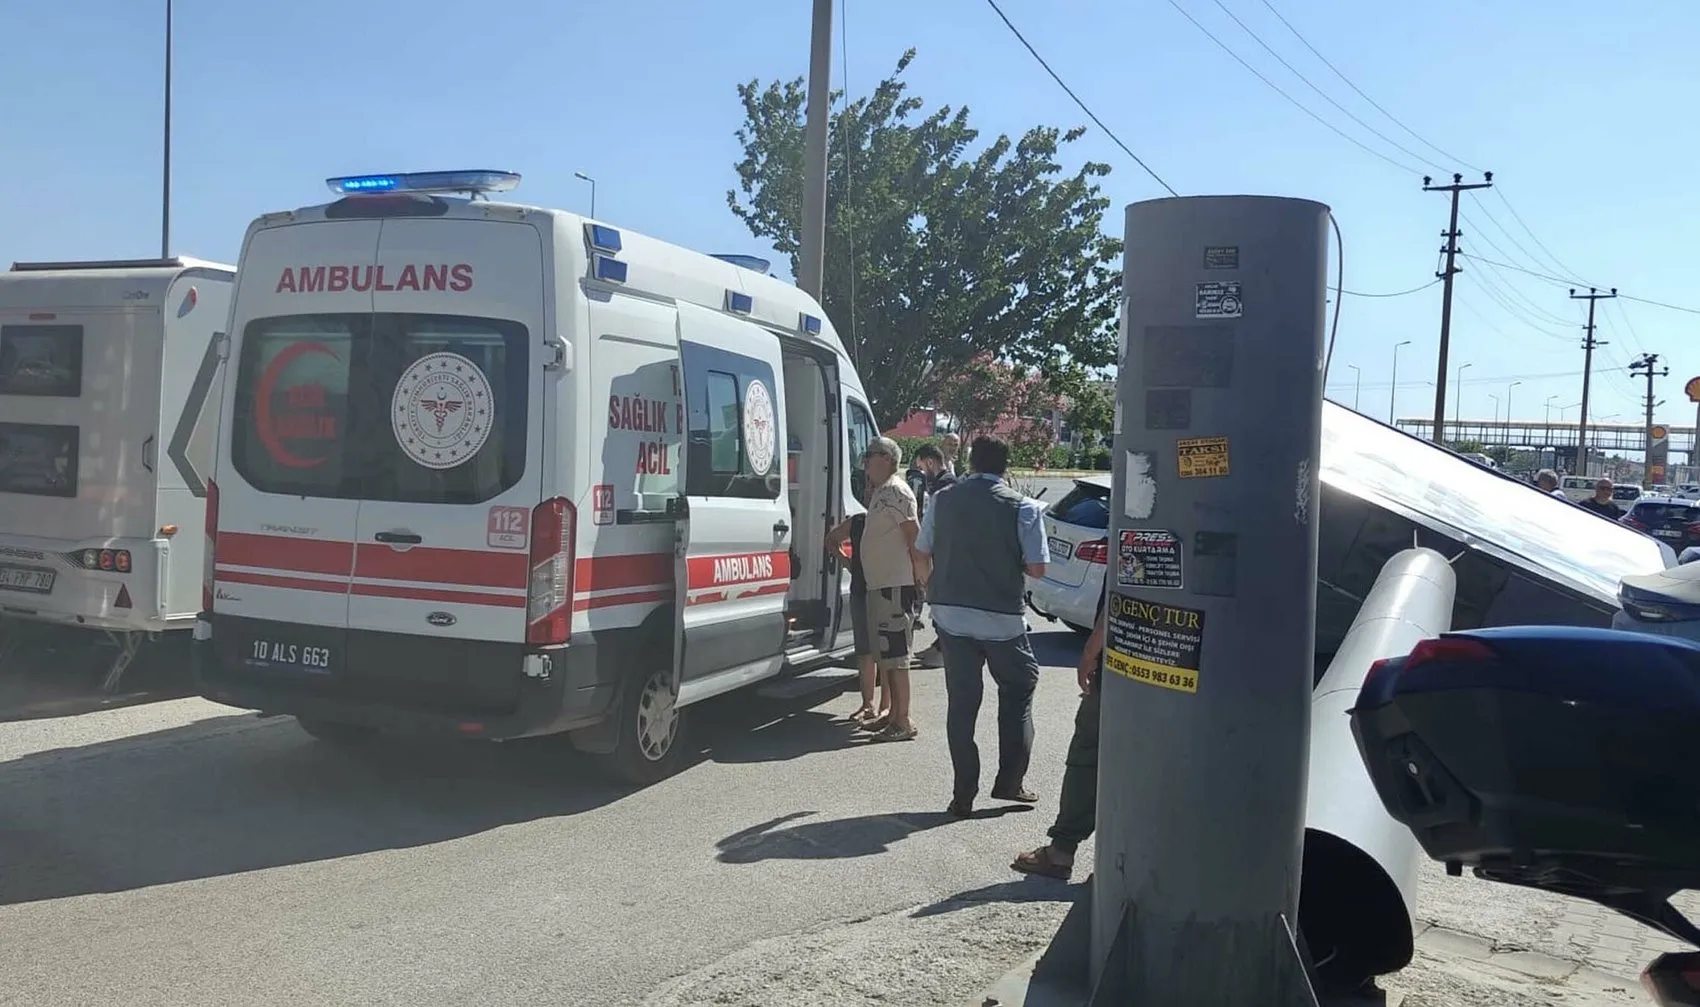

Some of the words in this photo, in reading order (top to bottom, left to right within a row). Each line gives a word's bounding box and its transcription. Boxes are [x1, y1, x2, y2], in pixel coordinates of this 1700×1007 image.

[275, 263, 473, 293] AMBULANS
[609, 392, 668, 434] SAĞLIK
[636, 437, 670, 475] ACİL
[595, 490, 611, 508] 112
[493, 510, 523, 531] 112
[713, 554, 773, 583] AMBULANS
[1122, 599, 1160, 626] GENÇ
[1163, 607, 1199, 628] TUR
[254, 640, 268, 659] 10
[271, 643, 297, 663] ALS
[302, 646, 329, 667] 663
[1152, 670, 1167, 683] 983
[1169, 674, 1180, 685] 63
[1182, 676, 1194, 688] 36
